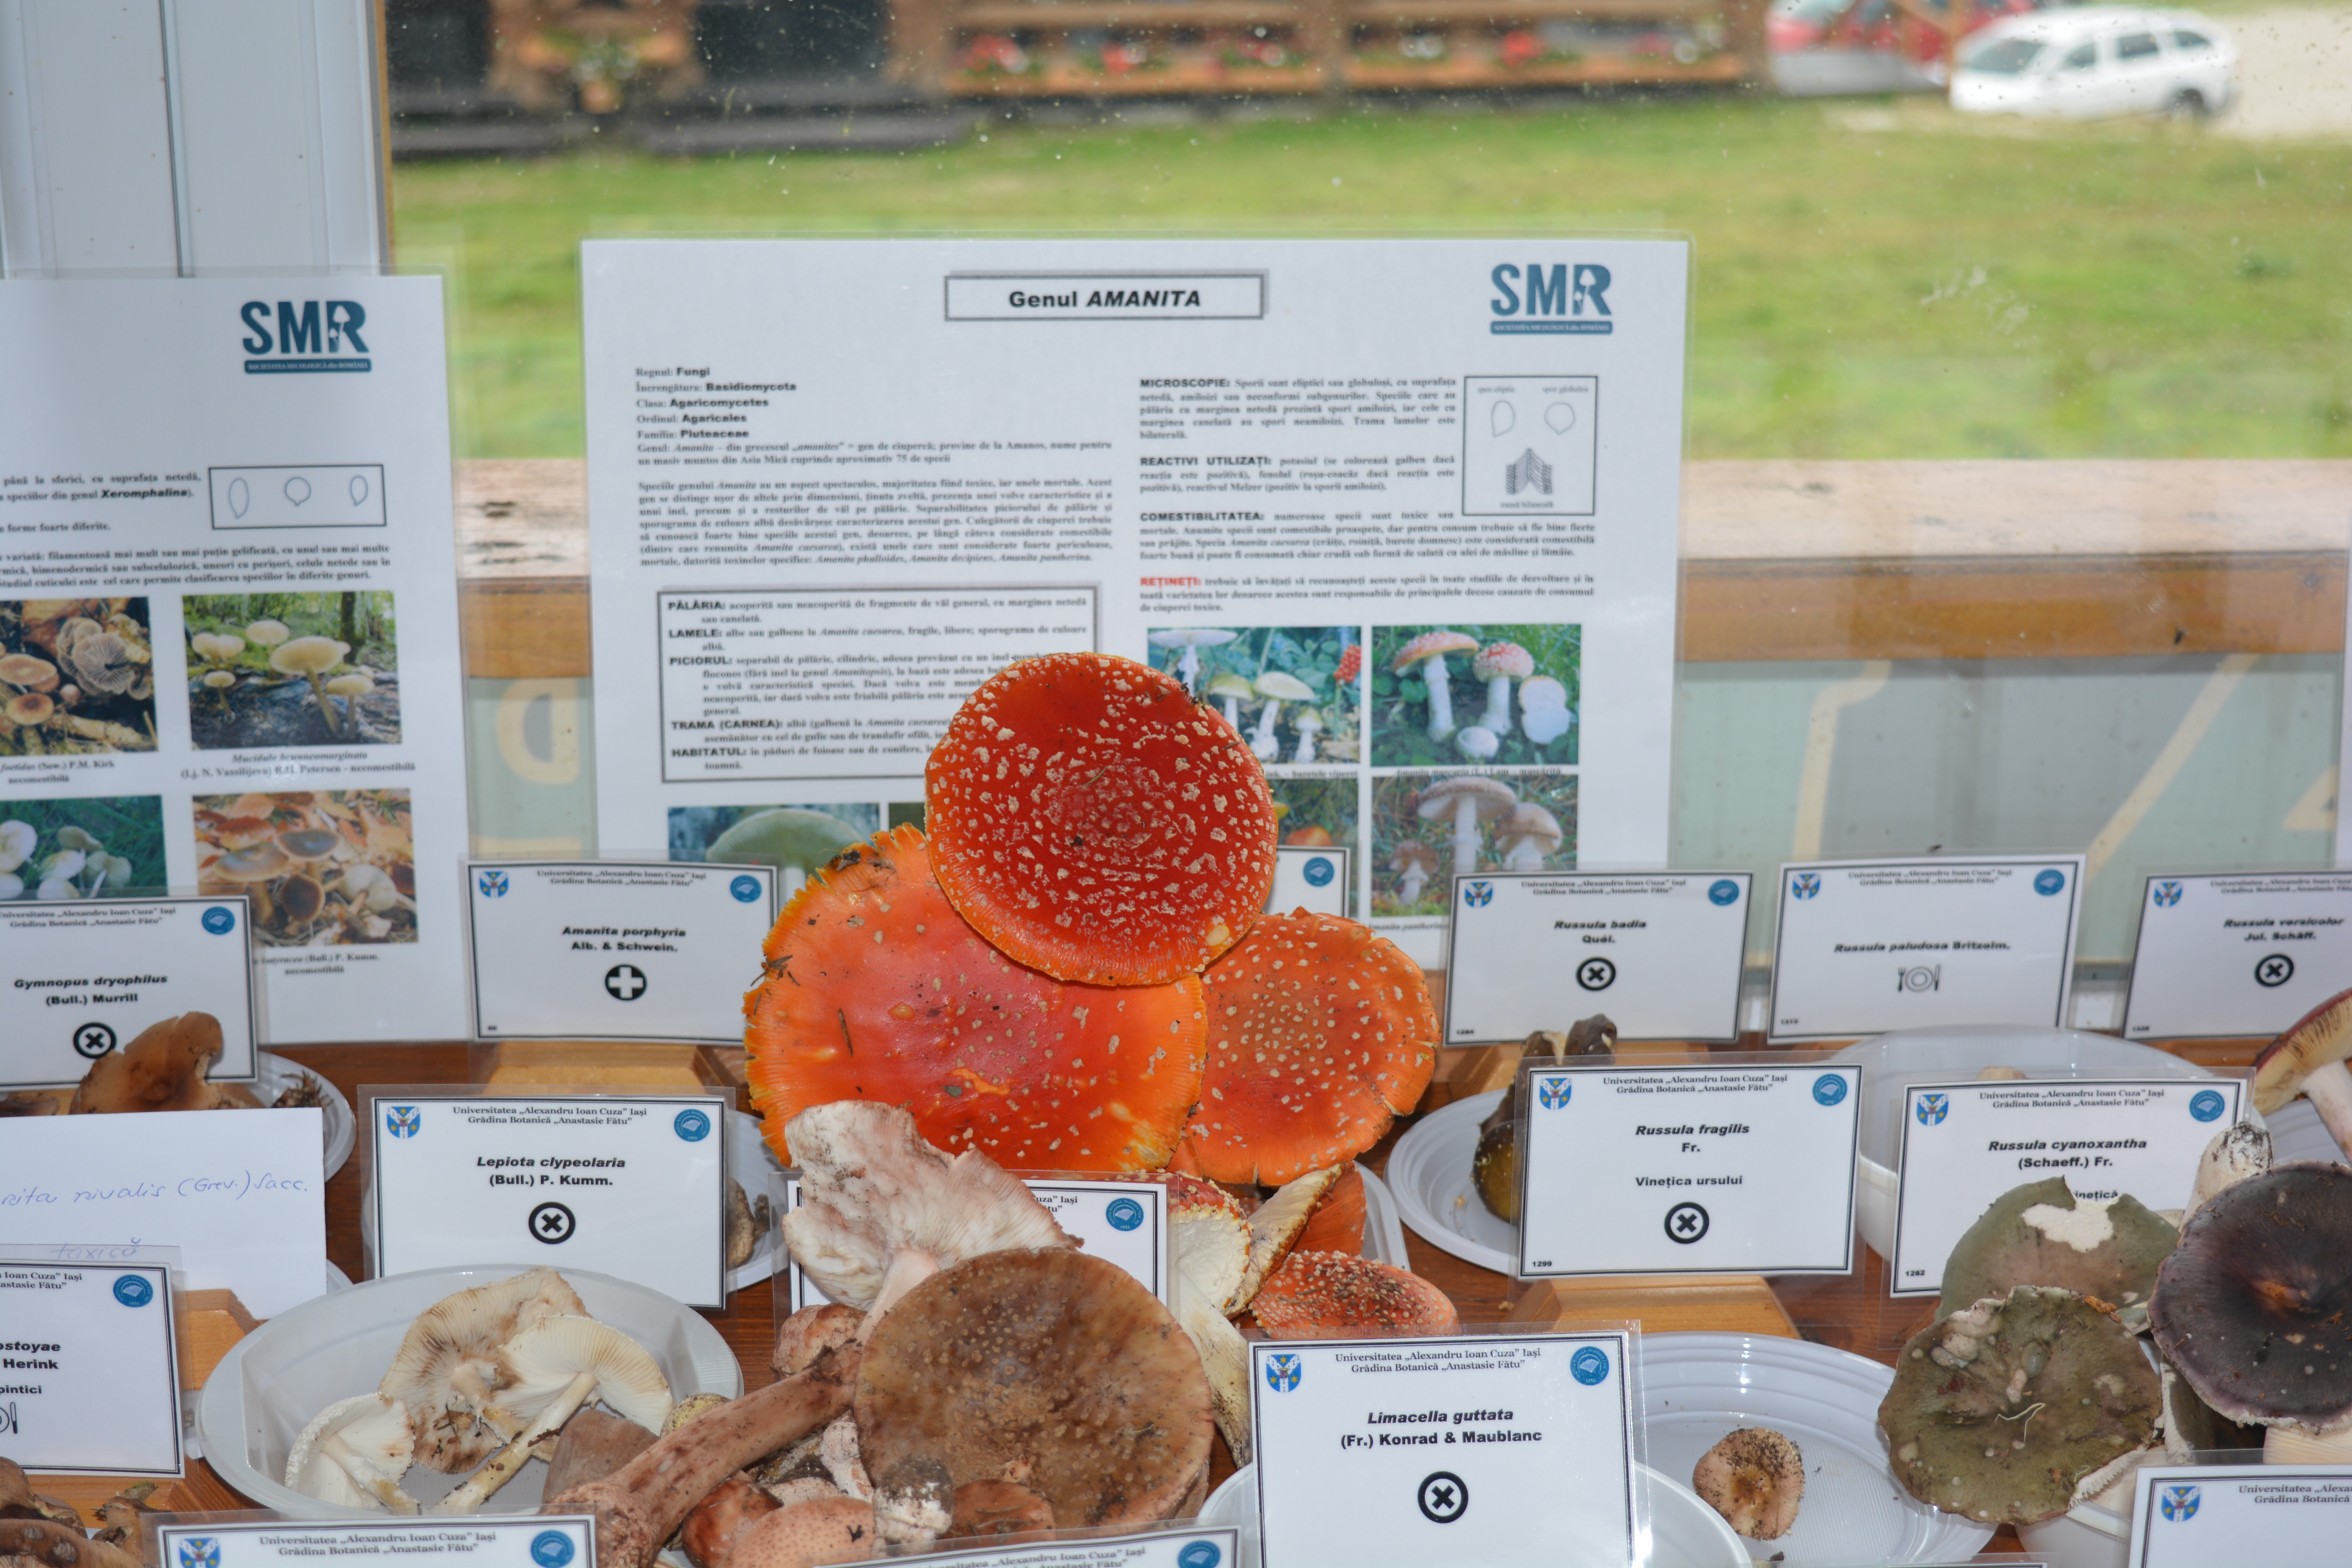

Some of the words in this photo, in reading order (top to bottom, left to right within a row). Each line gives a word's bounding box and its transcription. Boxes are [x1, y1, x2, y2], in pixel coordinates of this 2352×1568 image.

[1490, 264, 1612, 316] SMR
[1009, 290, 1078, 308] Genul
[1086, 290, 1200, 307] AMANITA
[241, 301, 369, 355] SMR
[636, 368, 673, 378] Regnul:
[676, 367, 710, 378] Fungi
[705, 382, 797, 393] Basidiomycota
[1140, 378, 1230, 388] MICROSCOPIE:
[636, 399, 666, 408] Clasa:
[670, 398, 769, 410] Agaricomycetes
[637, 415, 678, 423] Ordinul:
[682, 414, 747, 425] Agaricales
[638, 430, 678, 439] Familia:
[680, 429, 750, 438] Pluteaceae
[1140, 457, 1198, 466] REACTIVI
[7, 492, 48, 503] speciilor
[71, 490, 98, 501] genul
[1140, 512, 1264, 522] COMESTIBILITATEA:
[669, 629, 722, 638] LAMELE:
[669, 656, 733, 666] PICIORUL:
[671, 720, 715, 730] TRAMA
[719, 719, 782, 730] (CARNEA):
[671, 747, 746, 757] HABITATUL:
[1554, 920, 1607, 929] Russula
[1610, 920, 1647, 929] badia
[2223, 918, 2275, 928] Russula
[2279, 917, 2344, 927] versicolor
[562, 926, 619, 935] Amanita
[622, 927, 686, 938] porphyria
[2244, 933, 2267, 942] Jul.
[571, 941, 597, 950] Alb.
[602, 942, 612, 951] &
[617, 942, 678, 952] Schwein.
[1834, 943, 1886, 953] Russula
[1888, 941, 1949, 953] paludosa
[1952, 941, 2010, 950] Britzelm.
[14, 979, 89, 990] Gymnopus
[93, 975, 168, 987] dryophilus
[45, 995, 88, 1007] (Bull.)
[92, 993, 138, 1003] Murrill
[1603, 1076, 1664, 1085] Universitatea
[1980, 1091, 2040, 1099] Universitatea
[1993, 1100, 2029, 1108] Grădina
[1635, 1124, 1694, 1135] Russula
[1698, 1123, 1750, 1136] fragilis
[1681, 1142, 1700, 1152] Fr.
[1988, 1140, 2047, 1151] Russula
[2051, 1138, 2147, 1152] cyanoxantha
[477, 1156, 535, 1169] Lepiota
[540, 1156, 626, 1169] clypeolaria
[2018, 1156, 2089, 1170] (Schaeff.)
[2094, 1156, 2113, 1166] Fr.
[489, 1174, 535, 1187] (Bull.)
[540, 1174, 554, 1185] P.
[560, 1175, 613, 1185] Kumm.
[1635, 1176, 1692, 1189] Vinețica
[1696, 1175, 1742, 1185] ursului
[2073, 1190, 2118, 1201] inețică
[1335, 1352, 1402, 1362] Universitatea
[3, 1358, 59, 1369] Herink
[1351, 1363, 1392, 1373] Grădina
[1395, 1362, 1439, 1372] Botanică
[1367, 1410, 1448, 1424] Limacella
[1453, 1408, 1514, 1425] guttata
[1341, 1434, 1374, 1449] (Fr.)
[1379, 1432, 1438, 1446] Konrad
[1444, 1432, 1457, 1444] &
[1462, 1430, 1542, 1443] Maublanc
[2239, 1485, 2312, 1493] Universitatea
[2254, 1495, 2299, 1503] Grădina
[2302, 1495, 2350, 1503] Botanică
[260, 1535, 338, 1544] Universitatea
[409, 1534, 436, 1542] Ioan
[278, 1547, 326, 1555] Grădina
[329, 1545, 380, 1555] Botanică
